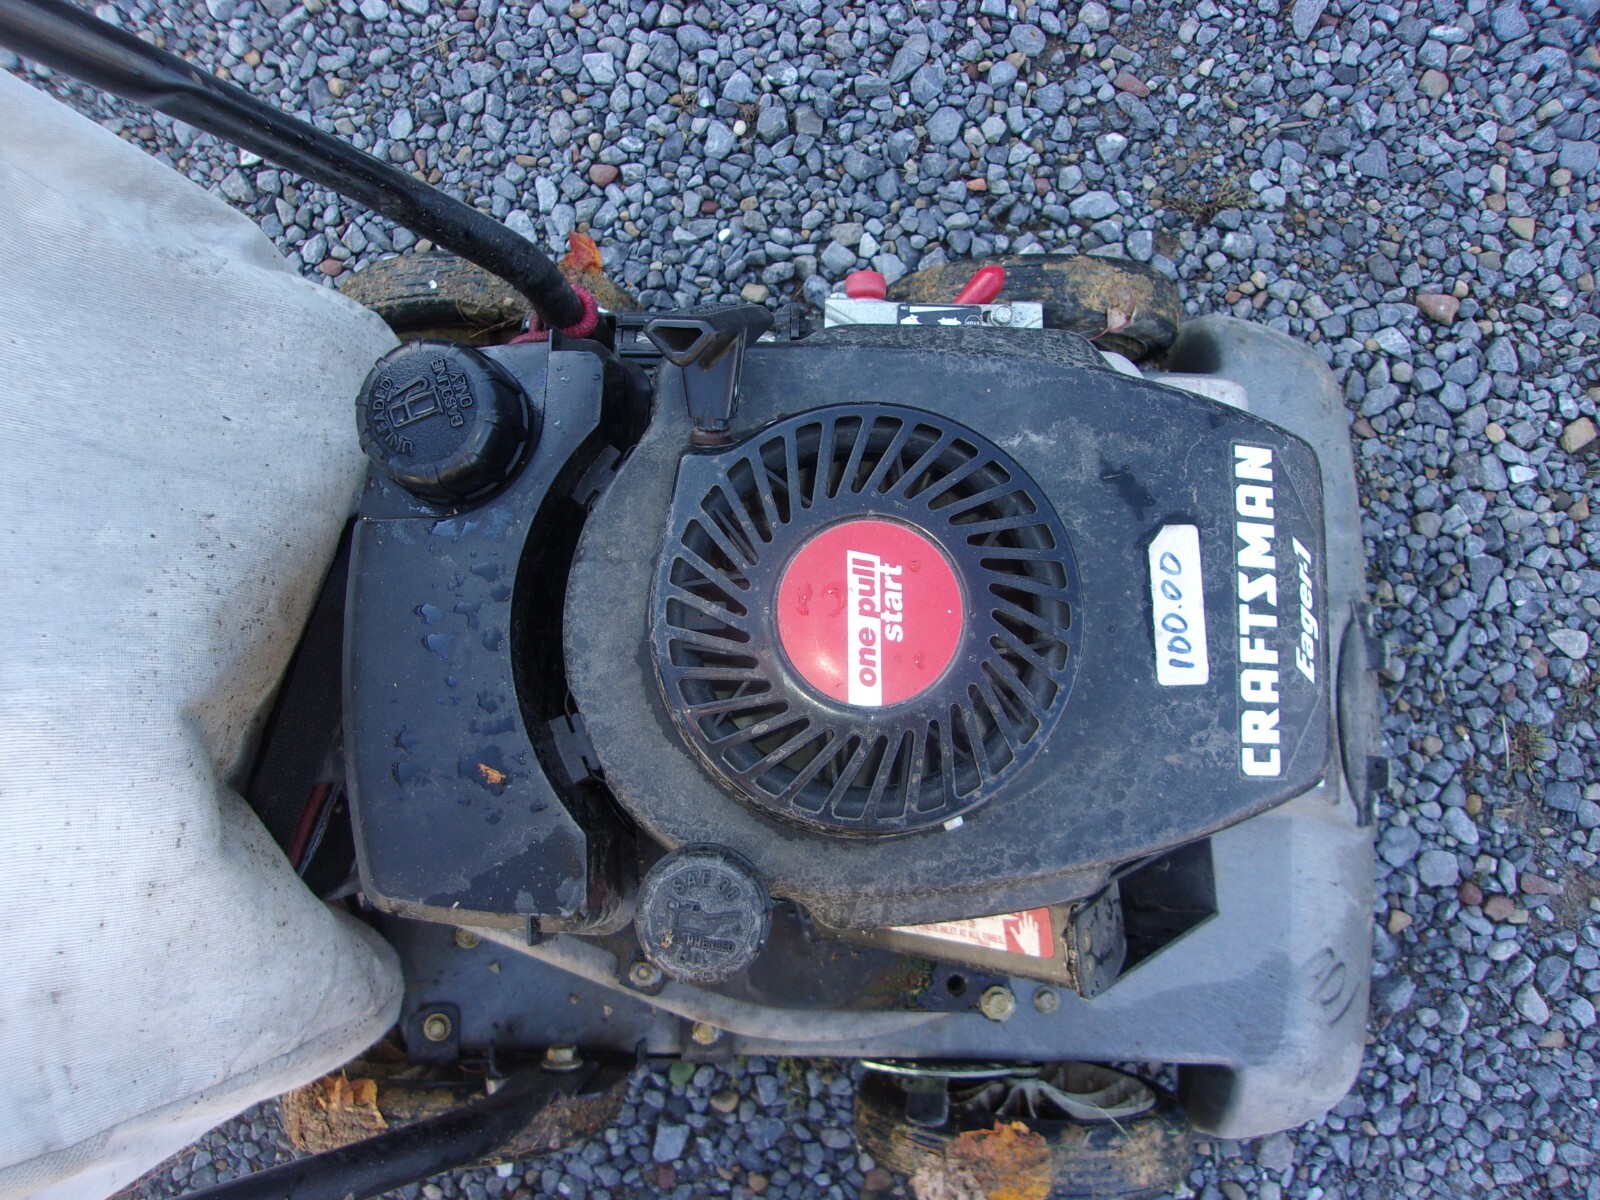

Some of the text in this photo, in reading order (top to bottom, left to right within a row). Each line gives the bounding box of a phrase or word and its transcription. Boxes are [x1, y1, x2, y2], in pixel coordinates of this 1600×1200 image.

[373, 377, 413, 452] UNLEADED
[431, 358, 464, 428] GASOLINE
[451, 372, 473, 409] ONLY
[852, 557, 880, 688] one pull
[880, 563, 904, 643] start
[1159, 551, 1195, 669] 100.00
[1234, 444, 1281, 777] CRAFTSMAN
[1292, 536, 1319, 685] Eager-1
[672, 869, 712, 894] SAE
